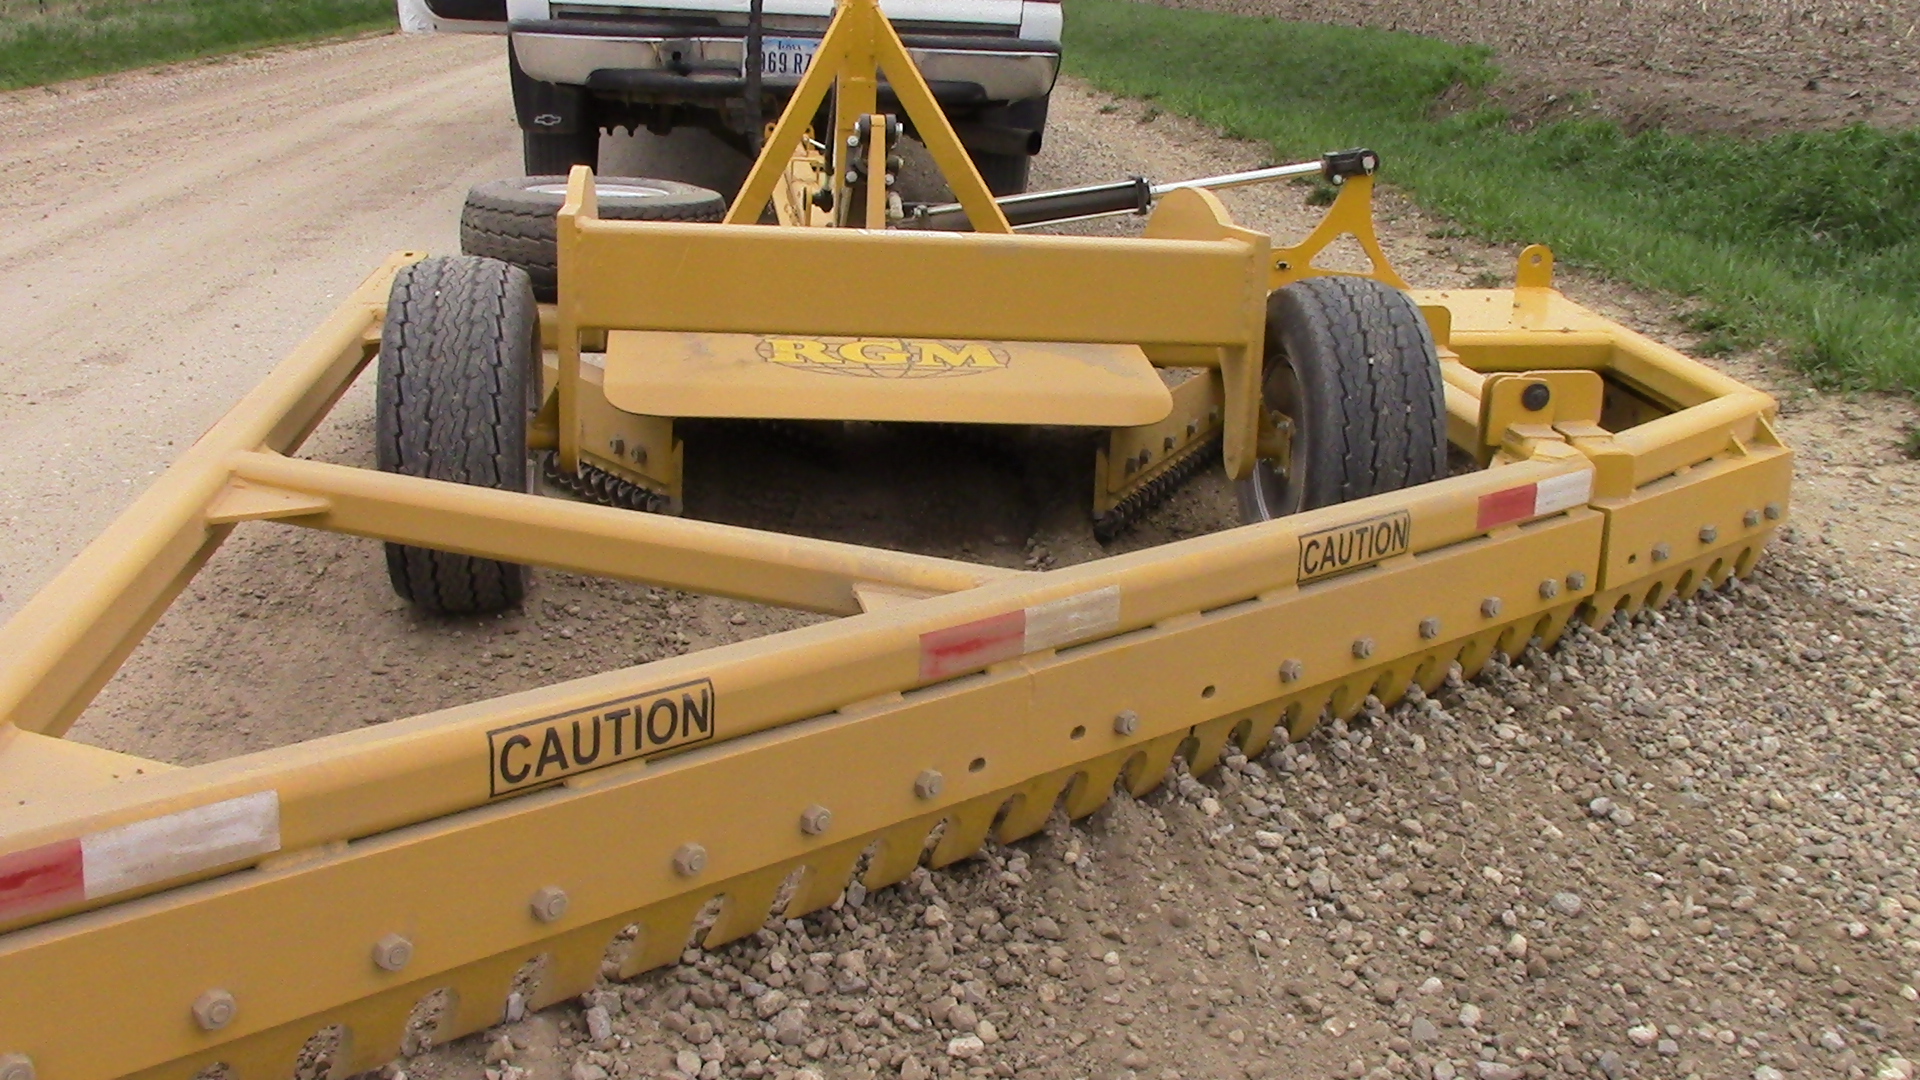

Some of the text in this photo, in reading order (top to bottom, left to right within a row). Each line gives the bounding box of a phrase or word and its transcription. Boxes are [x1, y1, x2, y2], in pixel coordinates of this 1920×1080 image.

[764, 338, 1008, 368] RGM
[1303, 517, 1407, 574] CAUTION
[500, 688, 709, 783] CAUTION
